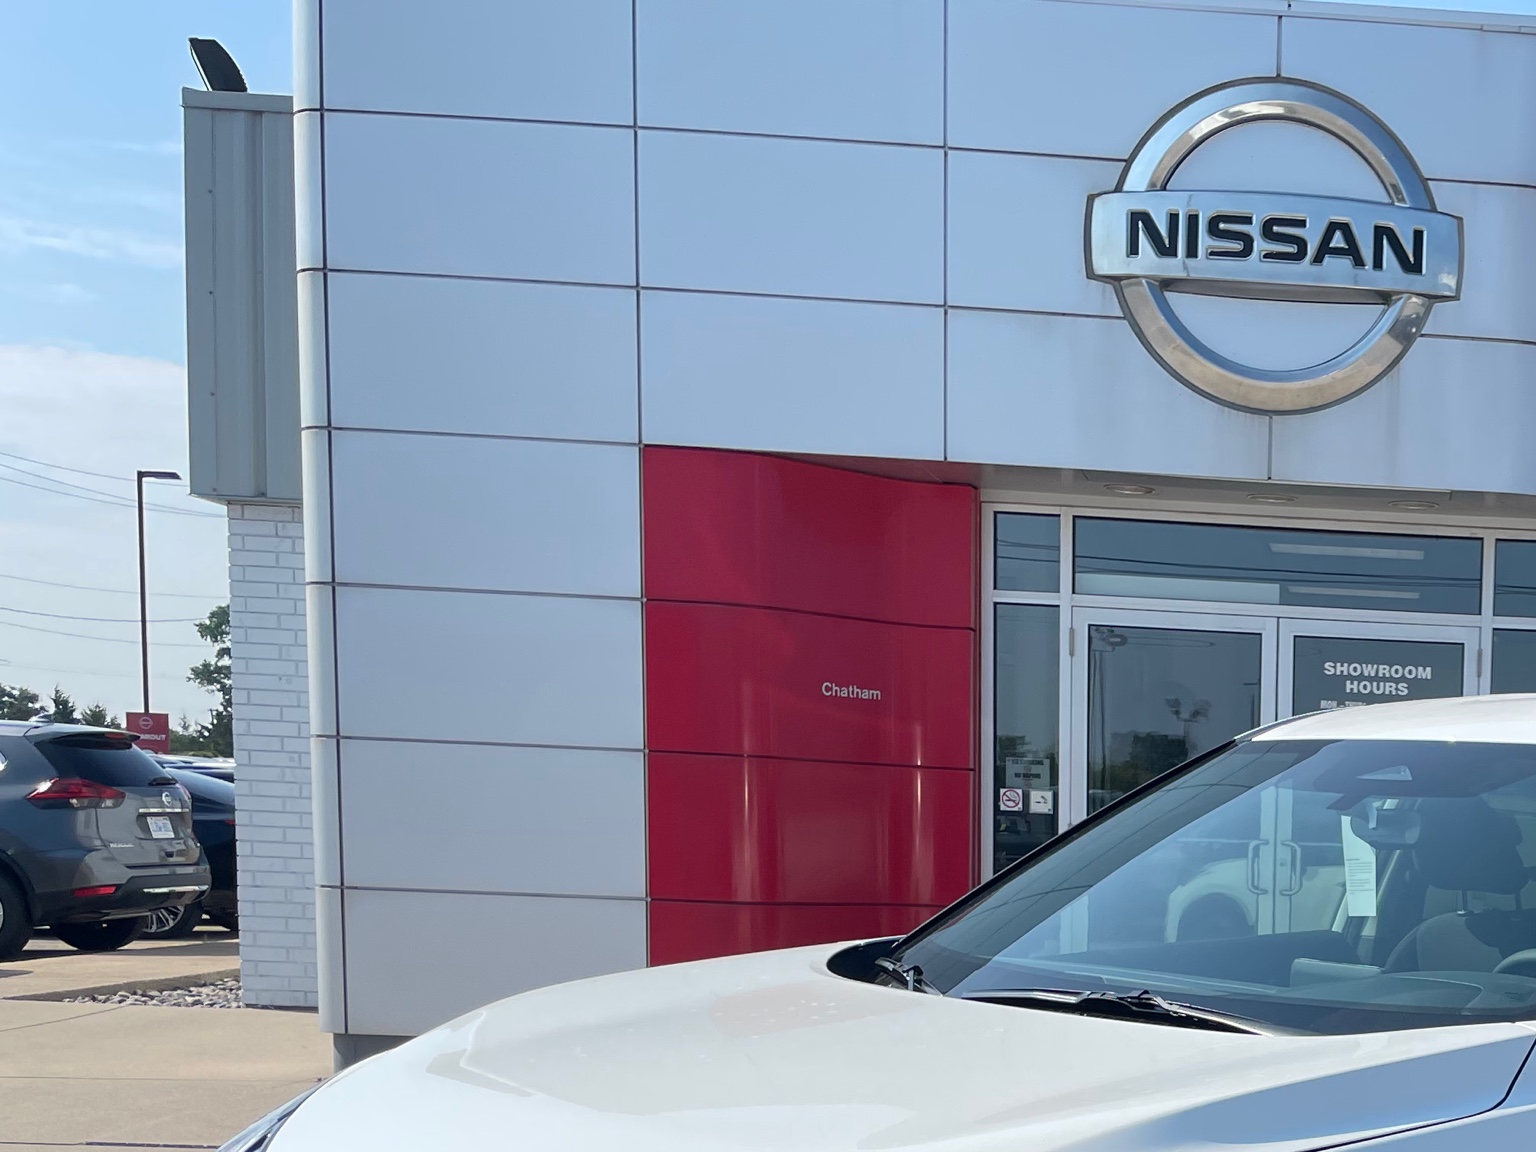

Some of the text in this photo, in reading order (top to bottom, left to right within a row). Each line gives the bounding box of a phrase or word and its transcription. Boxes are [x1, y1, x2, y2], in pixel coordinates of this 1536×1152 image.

[1126, 209, 1427, 276] NISSAN
[1323, 661, 1432, 680] SHOWROOM
[822, 682, 882, 700] Chatham
[1345, 680, 1409, 696] HOURS
